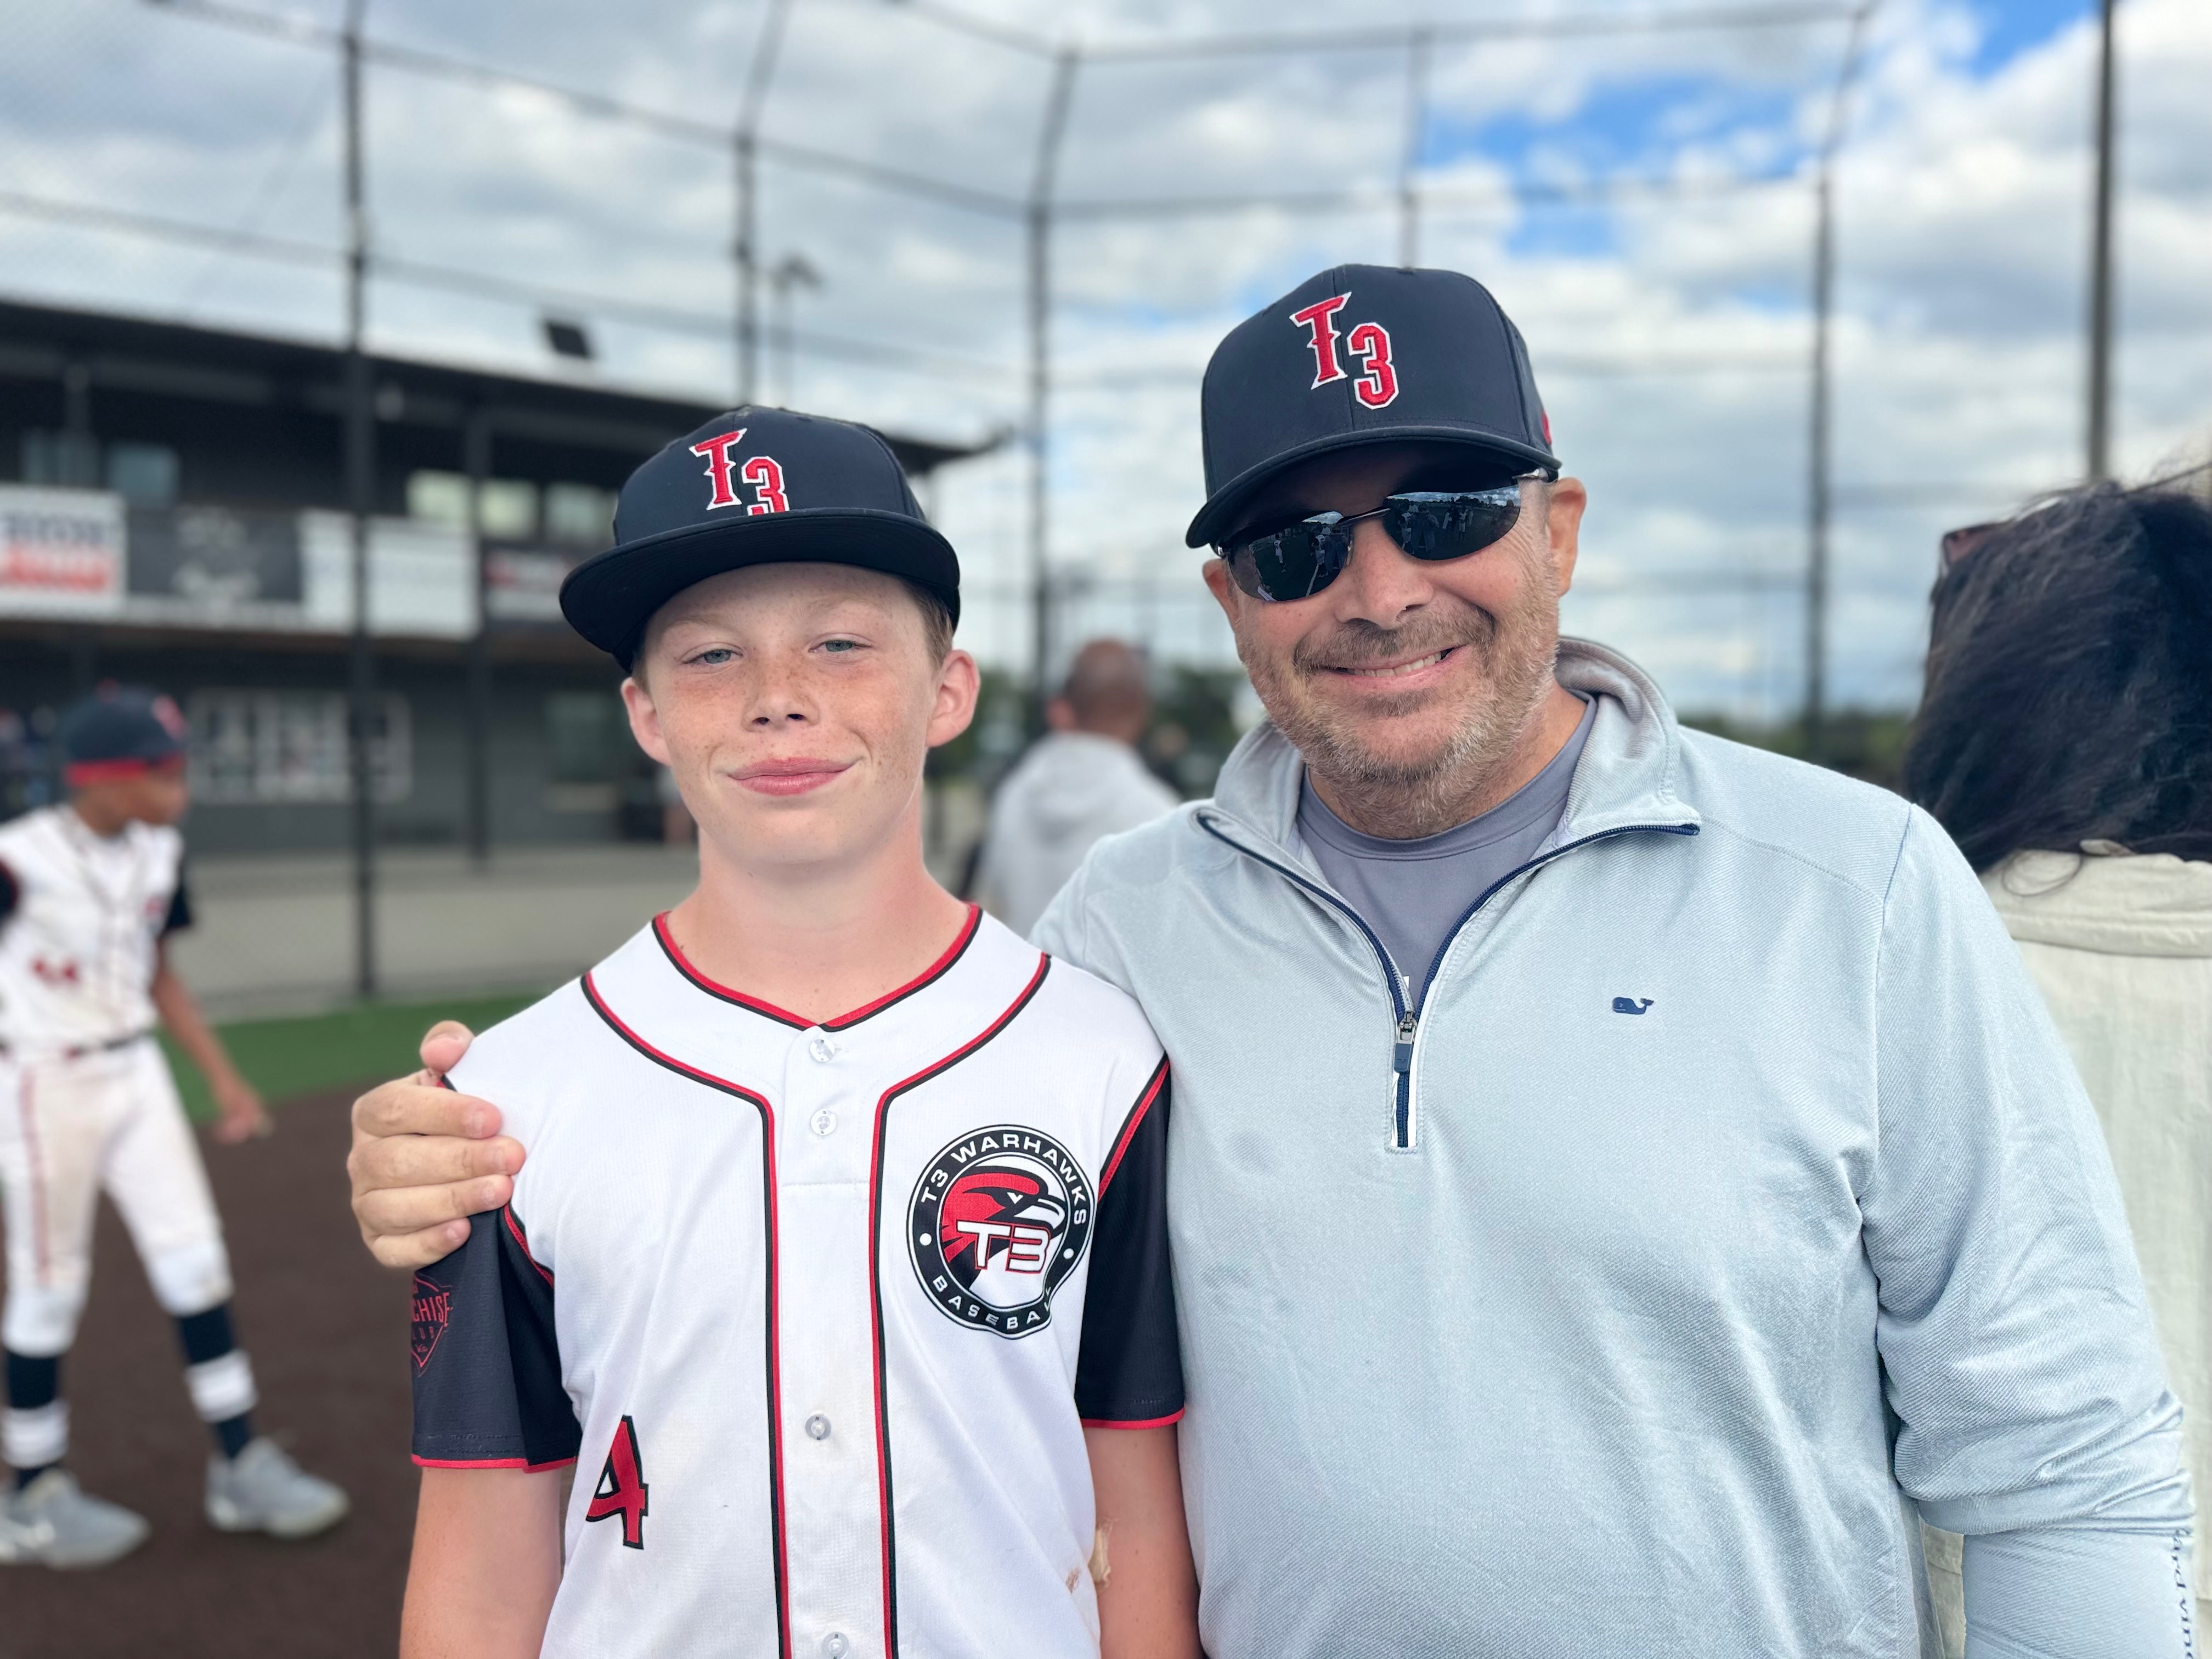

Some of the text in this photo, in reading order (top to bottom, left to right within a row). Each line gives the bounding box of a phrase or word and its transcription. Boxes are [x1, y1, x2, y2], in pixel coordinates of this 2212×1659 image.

[1289, 291, 1399, 409] T3
[689, 428, 790, 516] T3
[921, 1133, 1087, 1224] T3 WARHAWKS
[956, 1220, 1051, 1274] T3
[585, 1414, 649, 1550] 4
